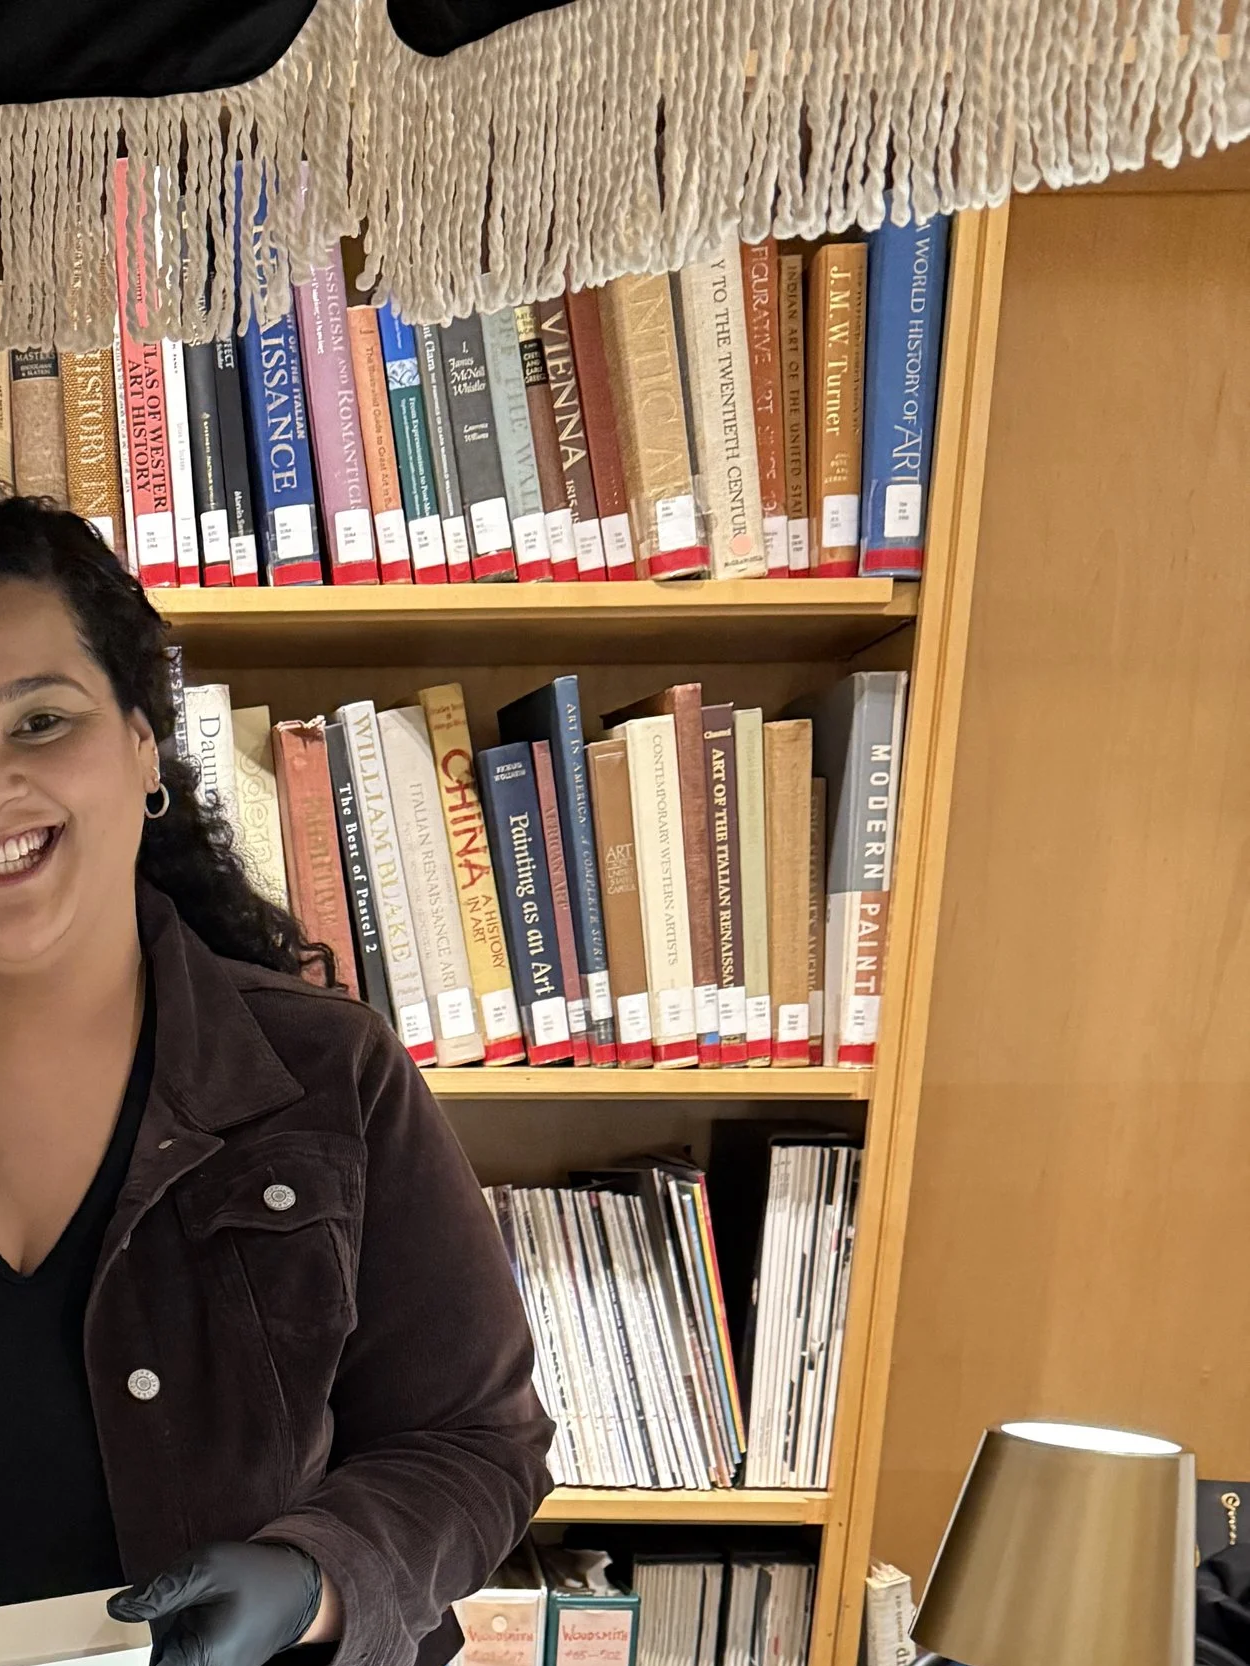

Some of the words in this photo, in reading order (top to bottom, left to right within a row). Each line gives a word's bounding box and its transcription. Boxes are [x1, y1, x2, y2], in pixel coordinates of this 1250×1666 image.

[712, 278, 727, 305] TO
[786, 265, 800, 317] INDIAN
[910, 236, 931, 313] WORLD
[751, 245, 772, 366] FIGURATIVE
[714, 308, 735, 349] THE
[787, 326, 800, 354] ART
[425, 341, 437, 371] Clara
[449, 357, 475, 372] James
[789, 361, 801, 379] OF
[902, 318, 924, 394] HISTORY
[129, 359, 144, 399] ART
[453, 383, 487, 397] Whistler
[541, 311, 587, 472] VIENNA
[824, 354, 849, 438] Turner
[146, 391, 161, 423] OF
[293, 388, 307, 439] ITALIAN
[374, 406, 384, 431] Guide
[718, 353, 741, 464] TWENTIETH
[790, 387, 802, 416] THE
[901, 400, 918, 427] OF
[132, 403, 152, 494] HISTORY
[378, 447, 388, 469] Great
[790, 423, 804, 479] UNITED
[891, 423, 923, 485] ART
[382, 473, 390, 488] Art
[565, 703, 578, 733] ART
[572, 763, 587, 825] AMERICA
[711, 748, 726, 780] ART
[338, 782, 352, 816] The
[652, 734, 671, 845] CONTEMPORARY
[713, 783, 727, 804] OF
[439, 748, 493, 890] CHINA
[714, 808, 729, 841] THE
[863, 743, 892, 881] MODERN
[345, 823, 360, 857] Best
[352, 711, 394, 853] WILLIAM
[376, 858, 413, 963] BLAKE
[606, 843, 634, 863] ART
[509, 812, 537, 898] Painting
[352, 864, 368, 883] of
[409, 782, 432, 846] ITALIAN
[423, 850, 451, 957] RENAISSANCE
[440, 957, 457, 990] ART
[659, 847, 677, 909] WESTERN
[715, 843, 732, 907] ITALIAN
[356, 888, 377, 938] Pastel
[467, 896, 480, 910] IN
[481, 894, 493, 906] A
[520, 900, 540, 924] as
[470, 915, 488, 945] ART
[483, 909, 507, 970] HISTORY
[526, 930, 546, 957] an
[664, 910, 679, 969] ARTISTS
[365, 943, 378, 953] 2
[530, 962, 556, 997] Art
[561, 1624, 628, 1642] WOODSMITH
